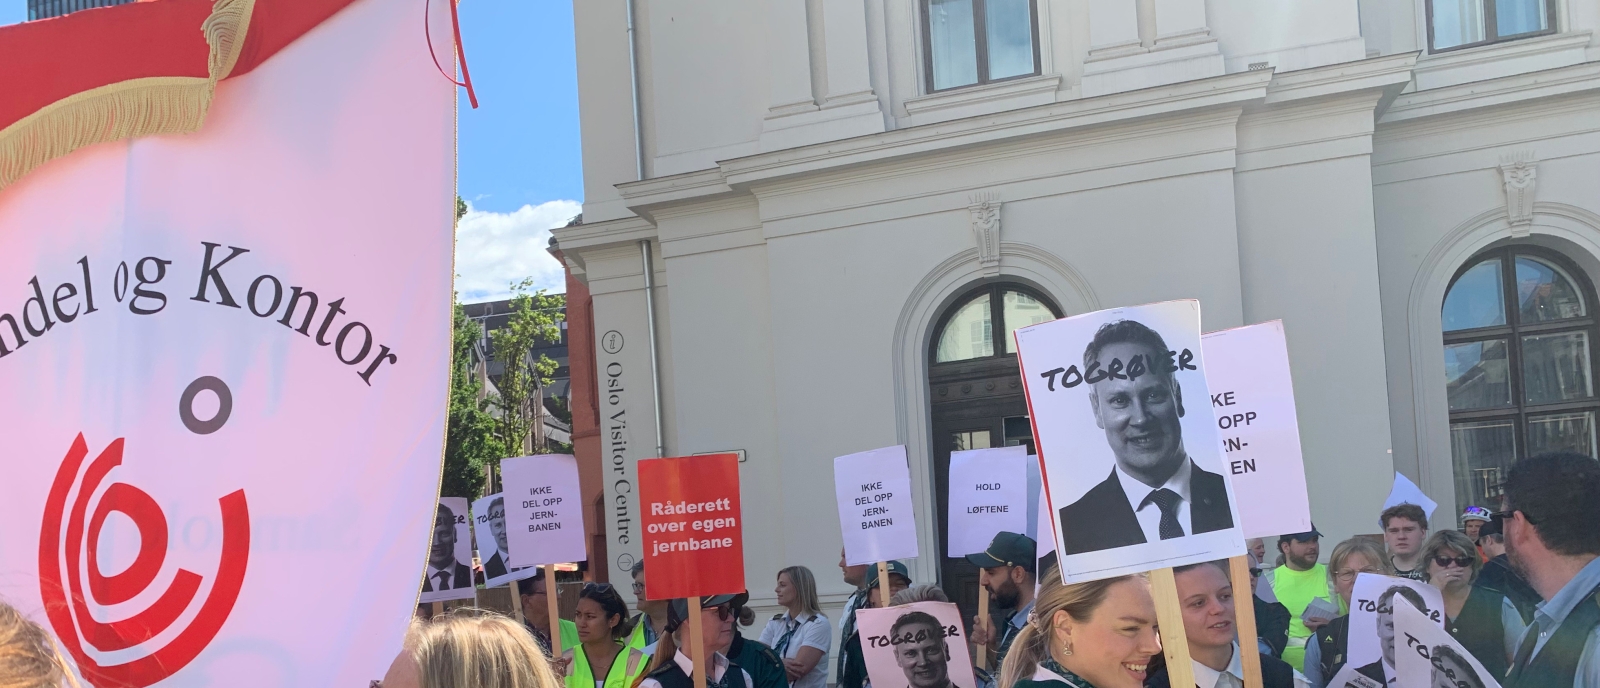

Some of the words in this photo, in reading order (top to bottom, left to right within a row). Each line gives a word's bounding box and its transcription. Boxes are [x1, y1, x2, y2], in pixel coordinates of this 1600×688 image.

[113, 256, 172, 315] og
[189, 241, 398, 387] Kontor
[606, 361, 625, 406] Oslo
[1218, 411, 1257, 430] OPP
[609, 408, 628, 476] Visitor
[529, 486, 553, 496] IKKE
[861, 481, 883, 492] IKKE
[975, 482, 1001, 491] HOLD
[522, 500, 541, 509] DEL
[542, 497, 563, 507] OPP
[854, 496, 873, 506] DEL
[874, 492, 893, 503] OPP
[613, 479, 632, 546] Centre
[651, 497, 731, 516] Råderett
[862, 506, 889, 517] JERN-
[966, 504, 1009, 514] LØFTENE
[529, 510, 558, 521] JERN-
[528, 522, 562, 533] BANEN
[647, 521, 687, 534] over
[691, 517, 736, 533] egen
[861, 517, 893, 530] BANEN
[652, 537, 733, 557] jernbane
